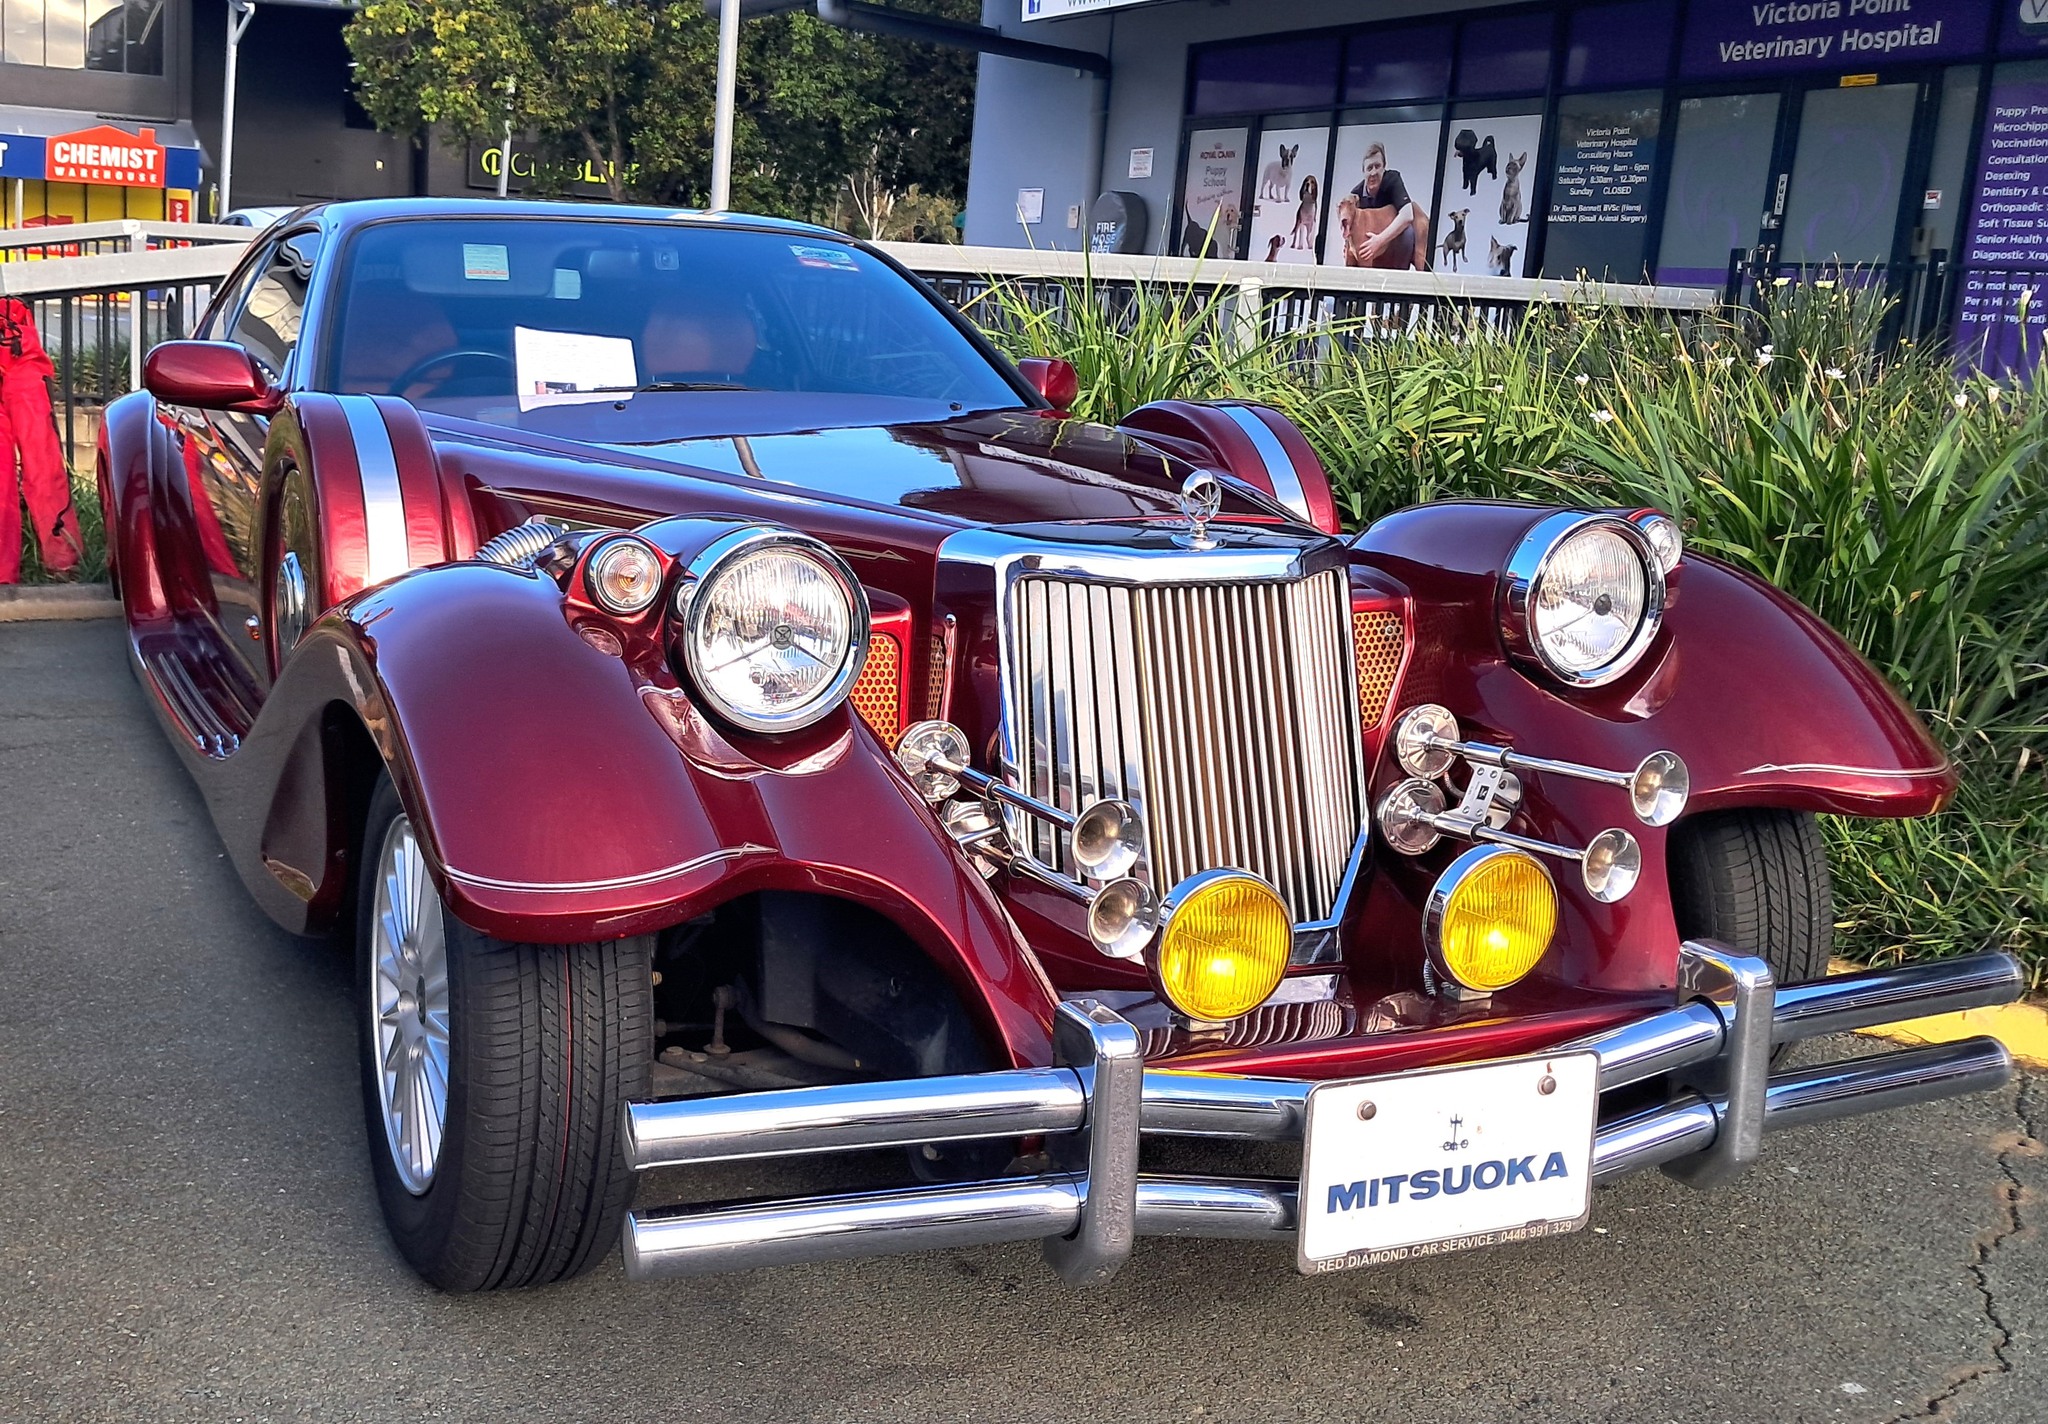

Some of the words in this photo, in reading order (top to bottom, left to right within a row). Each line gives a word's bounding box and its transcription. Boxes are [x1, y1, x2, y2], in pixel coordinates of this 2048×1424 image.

[1752, 1, 1841, 26] Victoria
[1850, 0, 1912, 16] Point
[1719, 34, 1833, 63] Veterinary
[1840, 20, 1942, 52] Hospital
[1995, 107, 2027, 118] Puppy
[1586, 127, 1611, 137] Victoria
[1612, 127, 1631, 136] Point
[1576, 139, 1609, 149] Veterinary
[1610, 138, 1639, 148] Hospital
[54, 142, 158, 170] CHEMIST
[1577, 151, 1611, 160] Consulting
[1612, 150, 1634, 158] Hours
[54, 166, 157, 183] WAREHOUSE
[1205, 165, 1228, 177] Puppy
[1558, 165, 1584, 174] Monday
[1589, 164, 1610, 174] Friday
[1558, 176, 1587, 185] Saturday
[1985, 171, 2031, 181] Desexing
[1203, 177, 1227, 187] School
[1569, 187, 1594, 197] Sunday
[1602, 186, 1632, 195] CLOSED
[1777, 180, 1786, 209] PULL
[1982, 186, 2029, 198] Dentistry
[2031, 185, 2039, 196] &
[1980, 201, 2043, 213] Orthopaedic
[1096, 222, 1116, 233] FIRE
[1978, 218, 1999, 228] Soft
[2003, 218, 2034, 228] Tissue
[1091, 233, 1117, 245] HOSE
[1975, 234, 2007, 244] Senior
[2010, 234, 2042, 244] Health
[1972, 250, 2025, 261] Diagnostic
[1326, 1151, 1569, 1214] MITSUOKA
[1316, 1258, 1344, 1273] RED
[1348, 1247, 1408, 1268] DIAMOND
[1411, 1243, 1439, 1258] CAR
[1441, 1233, 1495, 1253] SERVICE
[1501, 1229, 1527, 1243] 0448
[1529, 1224, 1549, 1238] 991
[1552, 1220, 1572, 1235] 329
